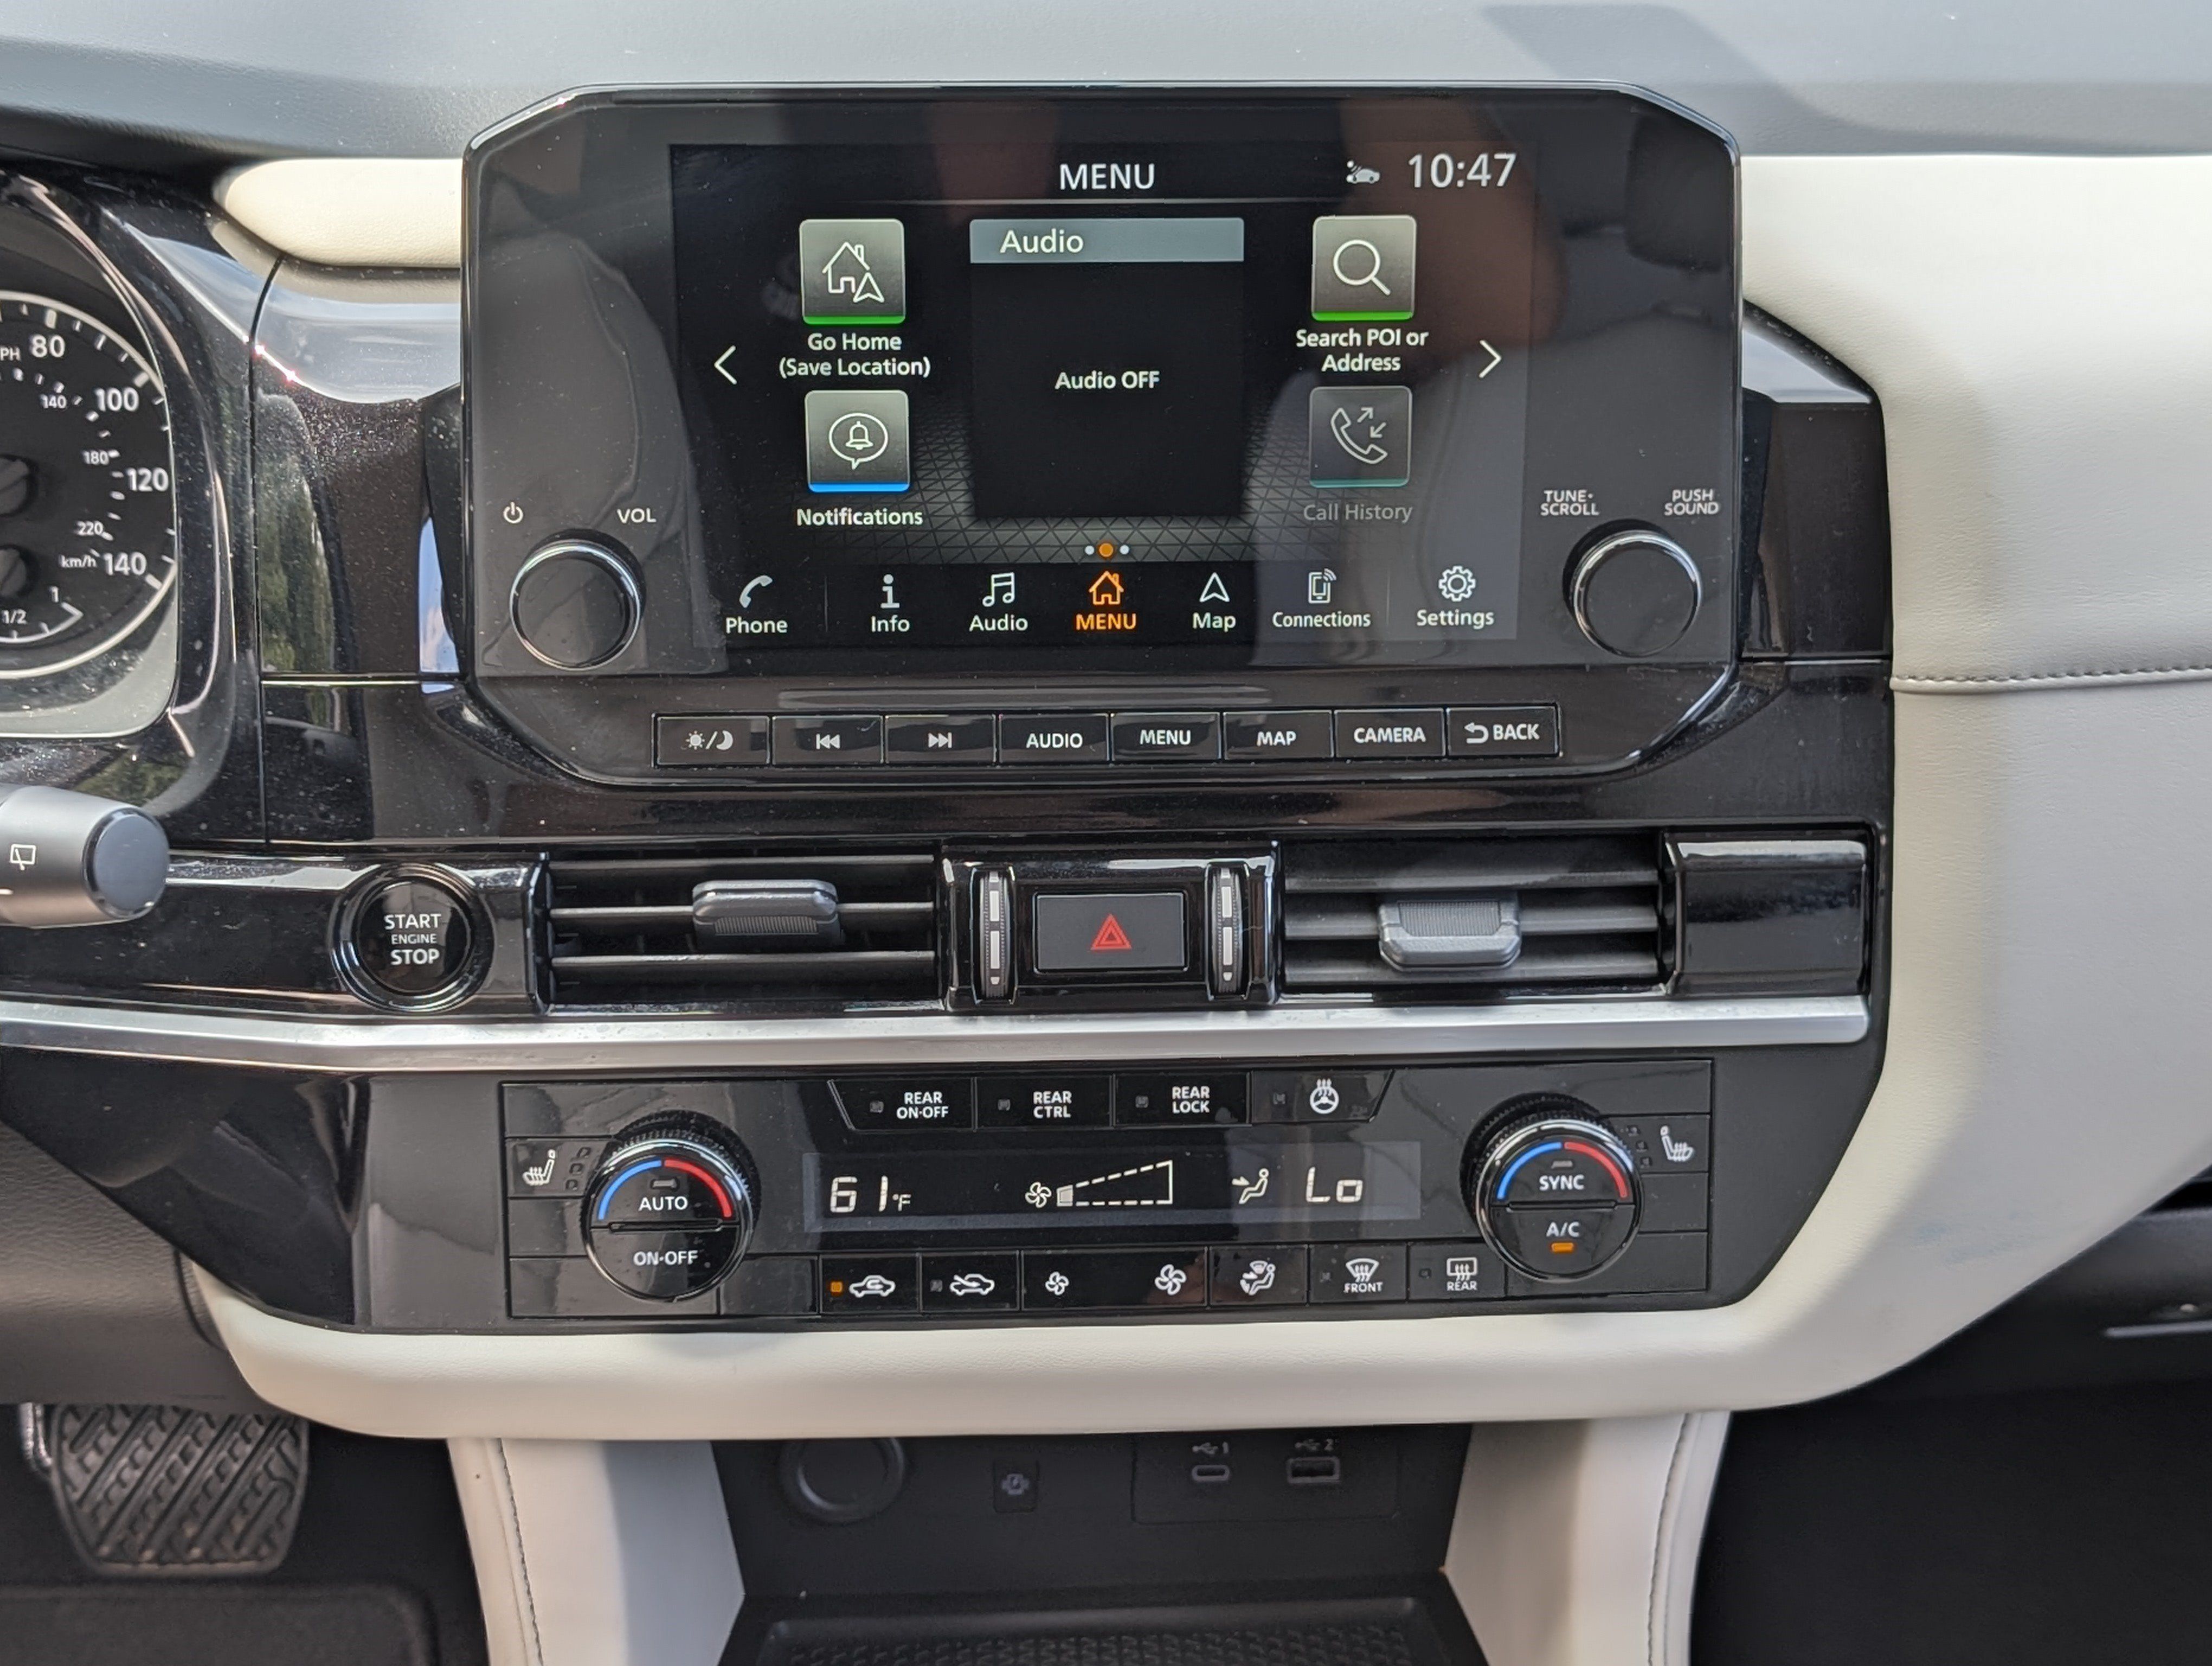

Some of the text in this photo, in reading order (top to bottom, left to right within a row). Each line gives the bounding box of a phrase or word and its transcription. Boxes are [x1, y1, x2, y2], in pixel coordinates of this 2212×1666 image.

[1060, 163, 1154, 190] MENU
[1409, 153, 1516, 188] 10:47
[1000, 228, 1084, 253] Audio
[808, 332, 902, 350] Go Home
[1296, 328, 1429, 347] Search POI or
[30, 334, 66, 358] 80
[779, 356, 931, 379] (Save Location)
[1321, 353, 1401, 371] Address
[1054, 370, 1160, 389] Audio OFF
[41, 395, 67, 408] 140
[95, 387, 139, 411] 100
[82, 451, 108, 465] 180
[127, 467, 169, 491] 120
[1672, 489, 1714, 502] PUSH
[617, 508, 657, 523] VOL
[797, 507, 923, 526] Notifications
[1303, 504, 1413, 524] Call History
[1540, 502, 1600, 516] SCROLL
[1664, 501, 1720, 516] SOUND
[77, 521, 103, 535] 220
[60, 554, 97, 568] km/h
[103, 552, 147, 575] 140
[3, 609, 27, 624] 1/2
[726, 616, 788, 633] Phone
[871, 614, 910, 632] Info
[969, 613, 1028, 632] Audio
[1076, 613, 1136, 630] MENU
[1193, 612, 1236, 632] Map
[1272, 611, 1371, 627] Connections
[1417, 609, 1494, 630] Settings
[1140, 729, 1191, 745] MENU
[1257, 731, 1296, 746] MAP
[1354, 727, 1426, 744] CAMERA
[1493, 723, 1540, 740] BACK
[1026, 733, 1083, 748] AUDIO
[384, 913, 442, 930] START
[391, 933, 437, 945] ENGINE
[391, 948, 440, 965] STOP
[904, 1091, 942, 1105] REAR
[1033, 1091, 1072, 1104] REAR
[1172, 1086, 1210, 1099] REAR
[1033, 1105, 1071, 1119] CTRL
[1172, 1100, 1210, 1113] LOCK
[1539, 1175, 1584, 1191] SYNC
[638, 1196, 688, 1211] AUTO
[1546, 1221, 1579, 1237] A/C
[1343, 1282, 1383, 1293] FRONT
[1446, 1280, 1477, 1292] REAR
